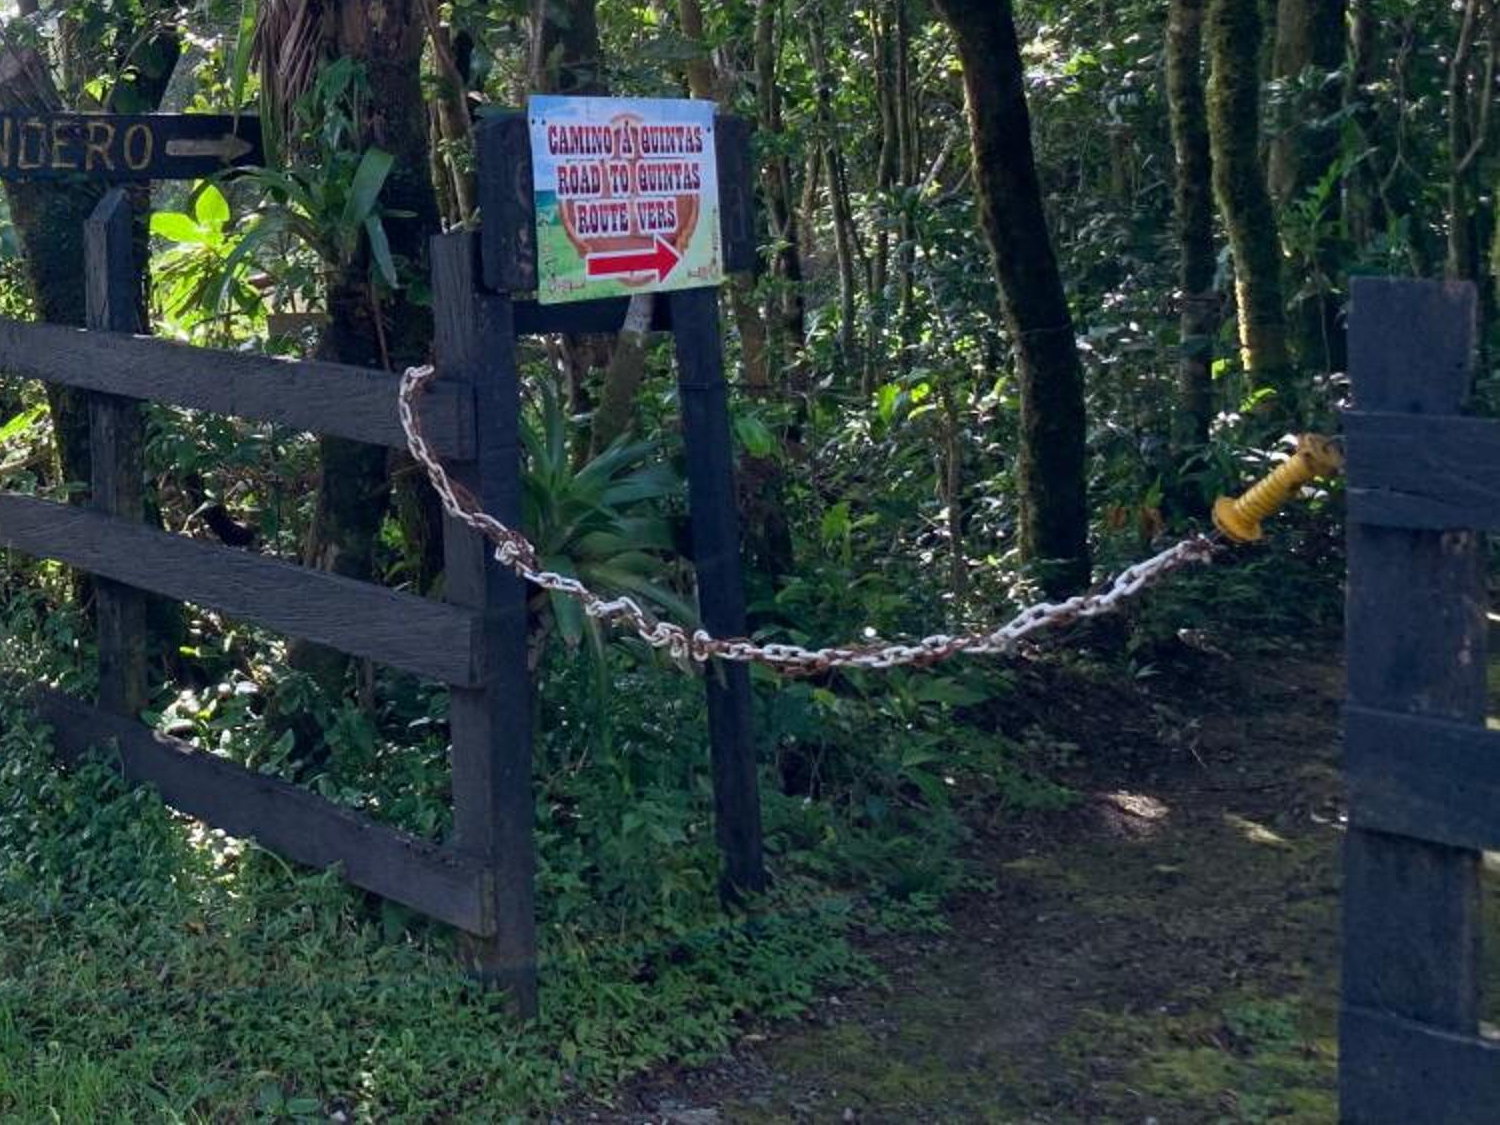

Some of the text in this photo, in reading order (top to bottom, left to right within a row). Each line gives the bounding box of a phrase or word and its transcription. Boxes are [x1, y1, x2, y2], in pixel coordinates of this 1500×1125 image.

[548, 125, 613, 156] CAMINO
[642, 126, 703, 154] QUINTAS
[557, 162, 701, 195] ROAD TO QUINTAS
[577, 201, 676, 234] ROUTE VERS
